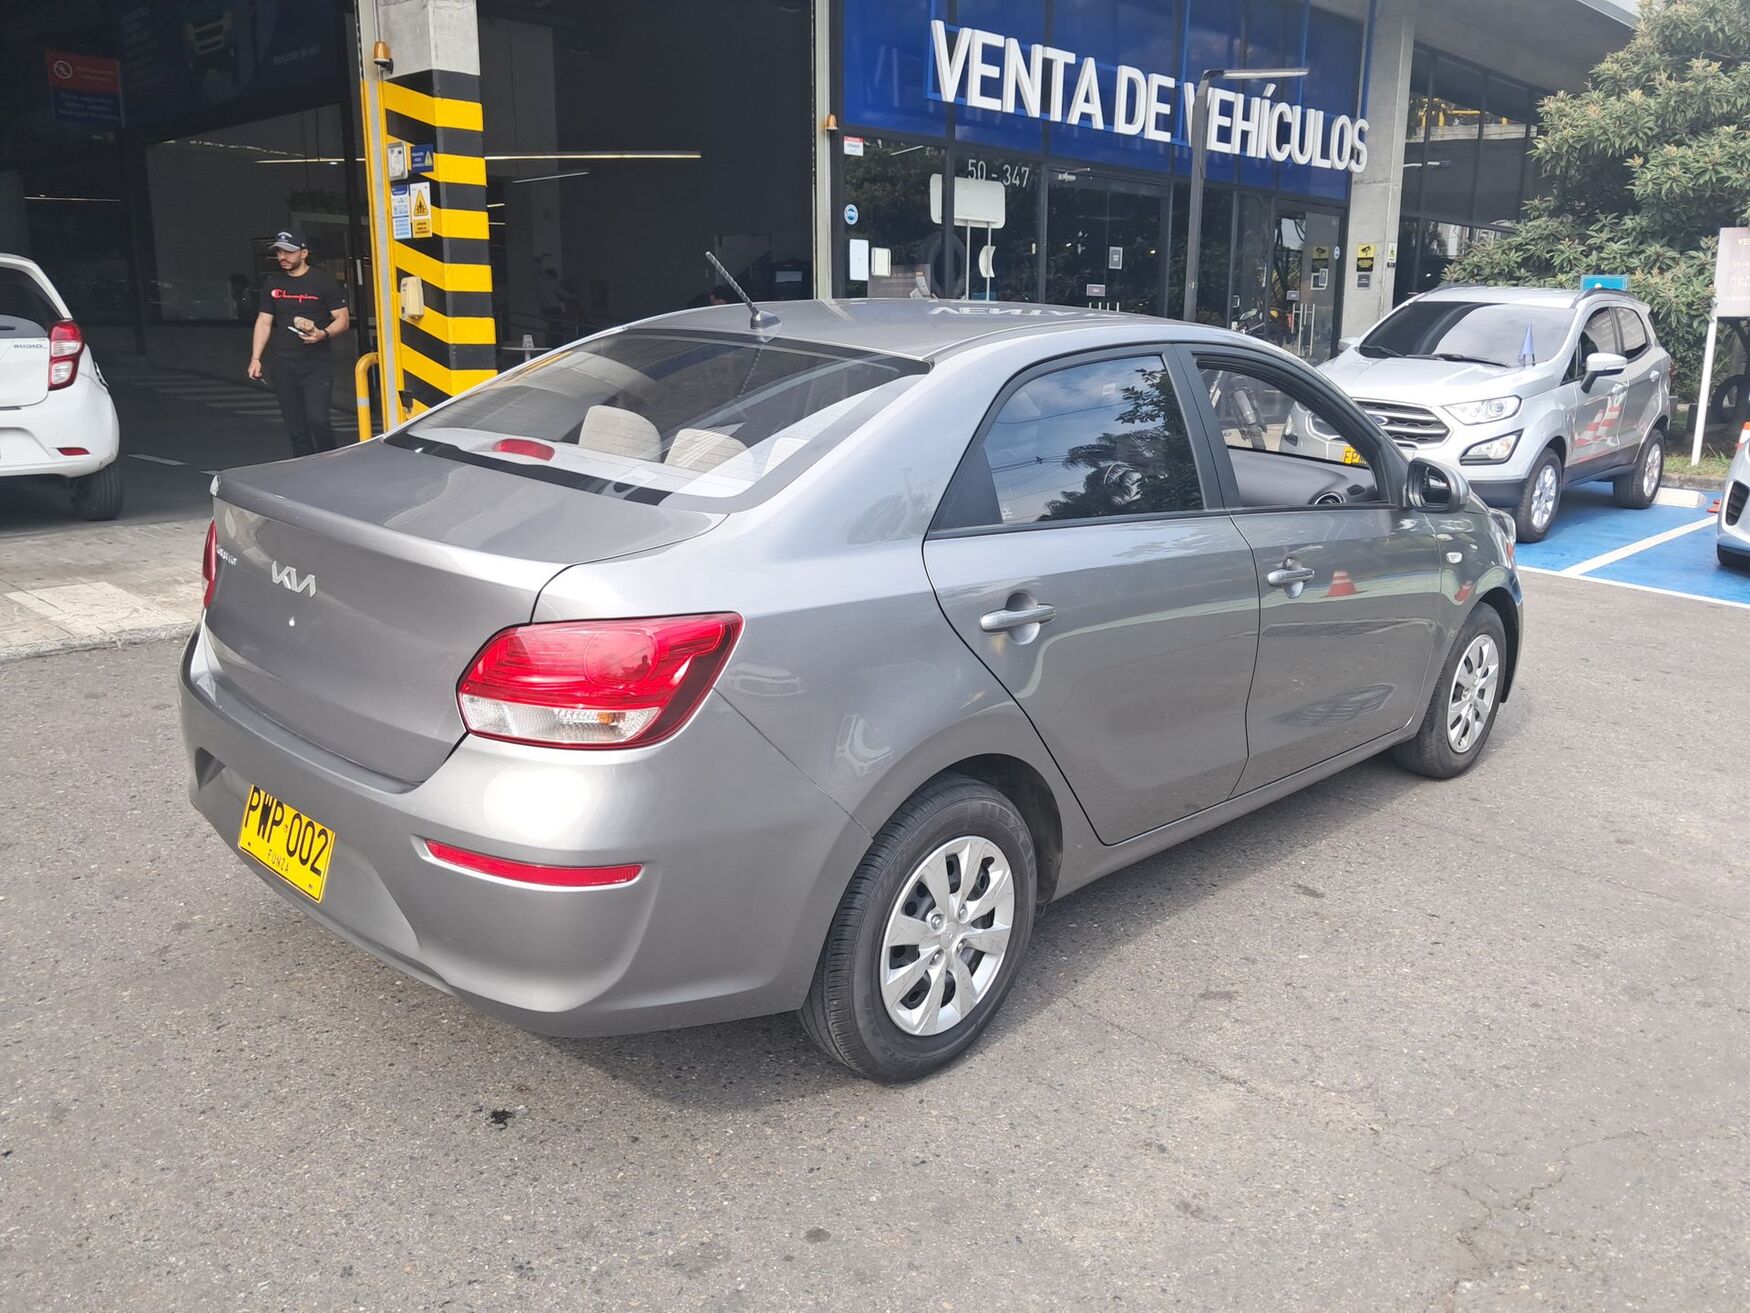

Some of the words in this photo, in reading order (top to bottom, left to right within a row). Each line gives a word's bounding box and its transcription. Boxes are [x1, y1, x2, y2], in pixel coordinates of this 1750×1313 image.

[930, 19, 1103, 130] VENTA
[1113, 65, 1175, 142] DE
[968, 159, 986, 180] 50
[1003, 164, 1030, 187] 347
